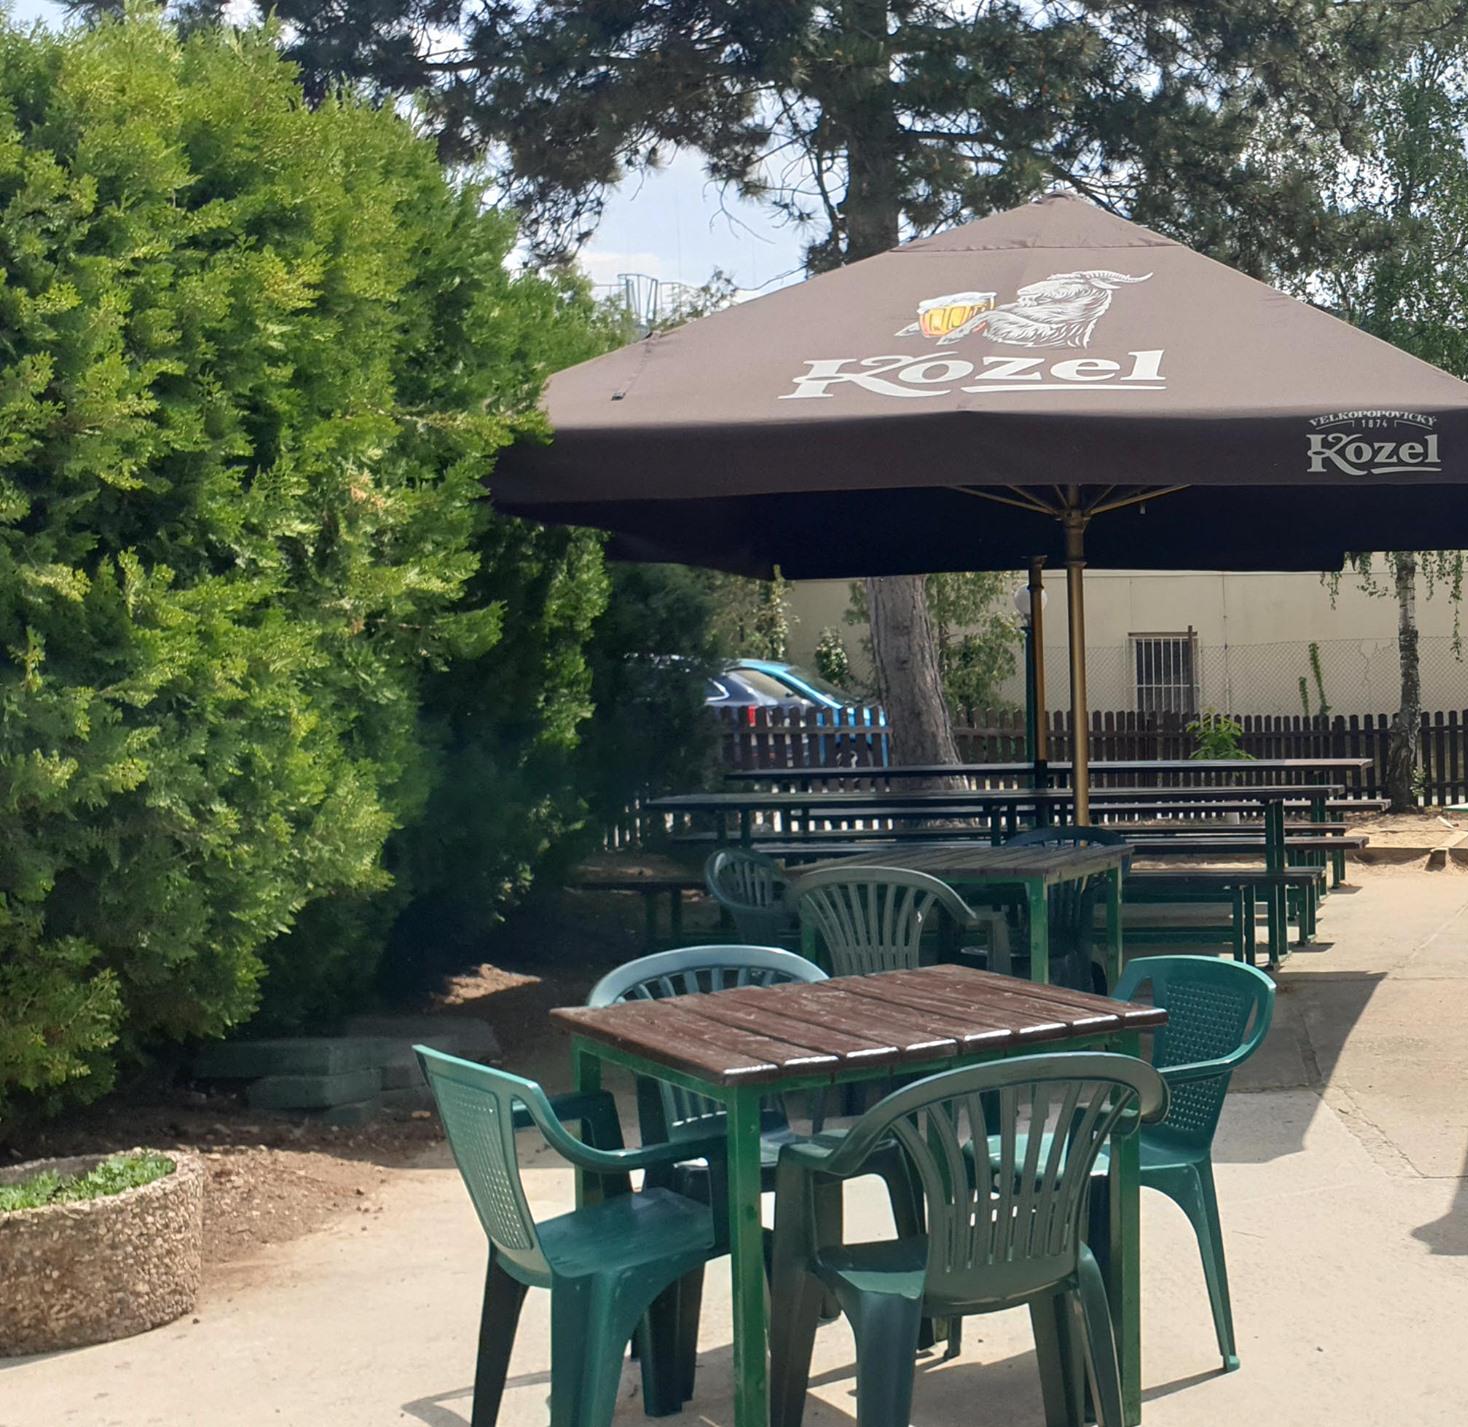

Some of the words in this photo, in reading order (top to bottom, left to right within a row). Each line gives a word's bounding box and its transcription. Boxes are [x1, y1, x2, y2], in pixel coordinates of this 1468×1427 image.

[778, 349, 1166, 399] Kozel
[1308, 410, 1437, 427] VELKOPOPOVICKÝ
[1362, 419, 1388, 428] 1874
[1305, 432, 1442, 476] Kozel
